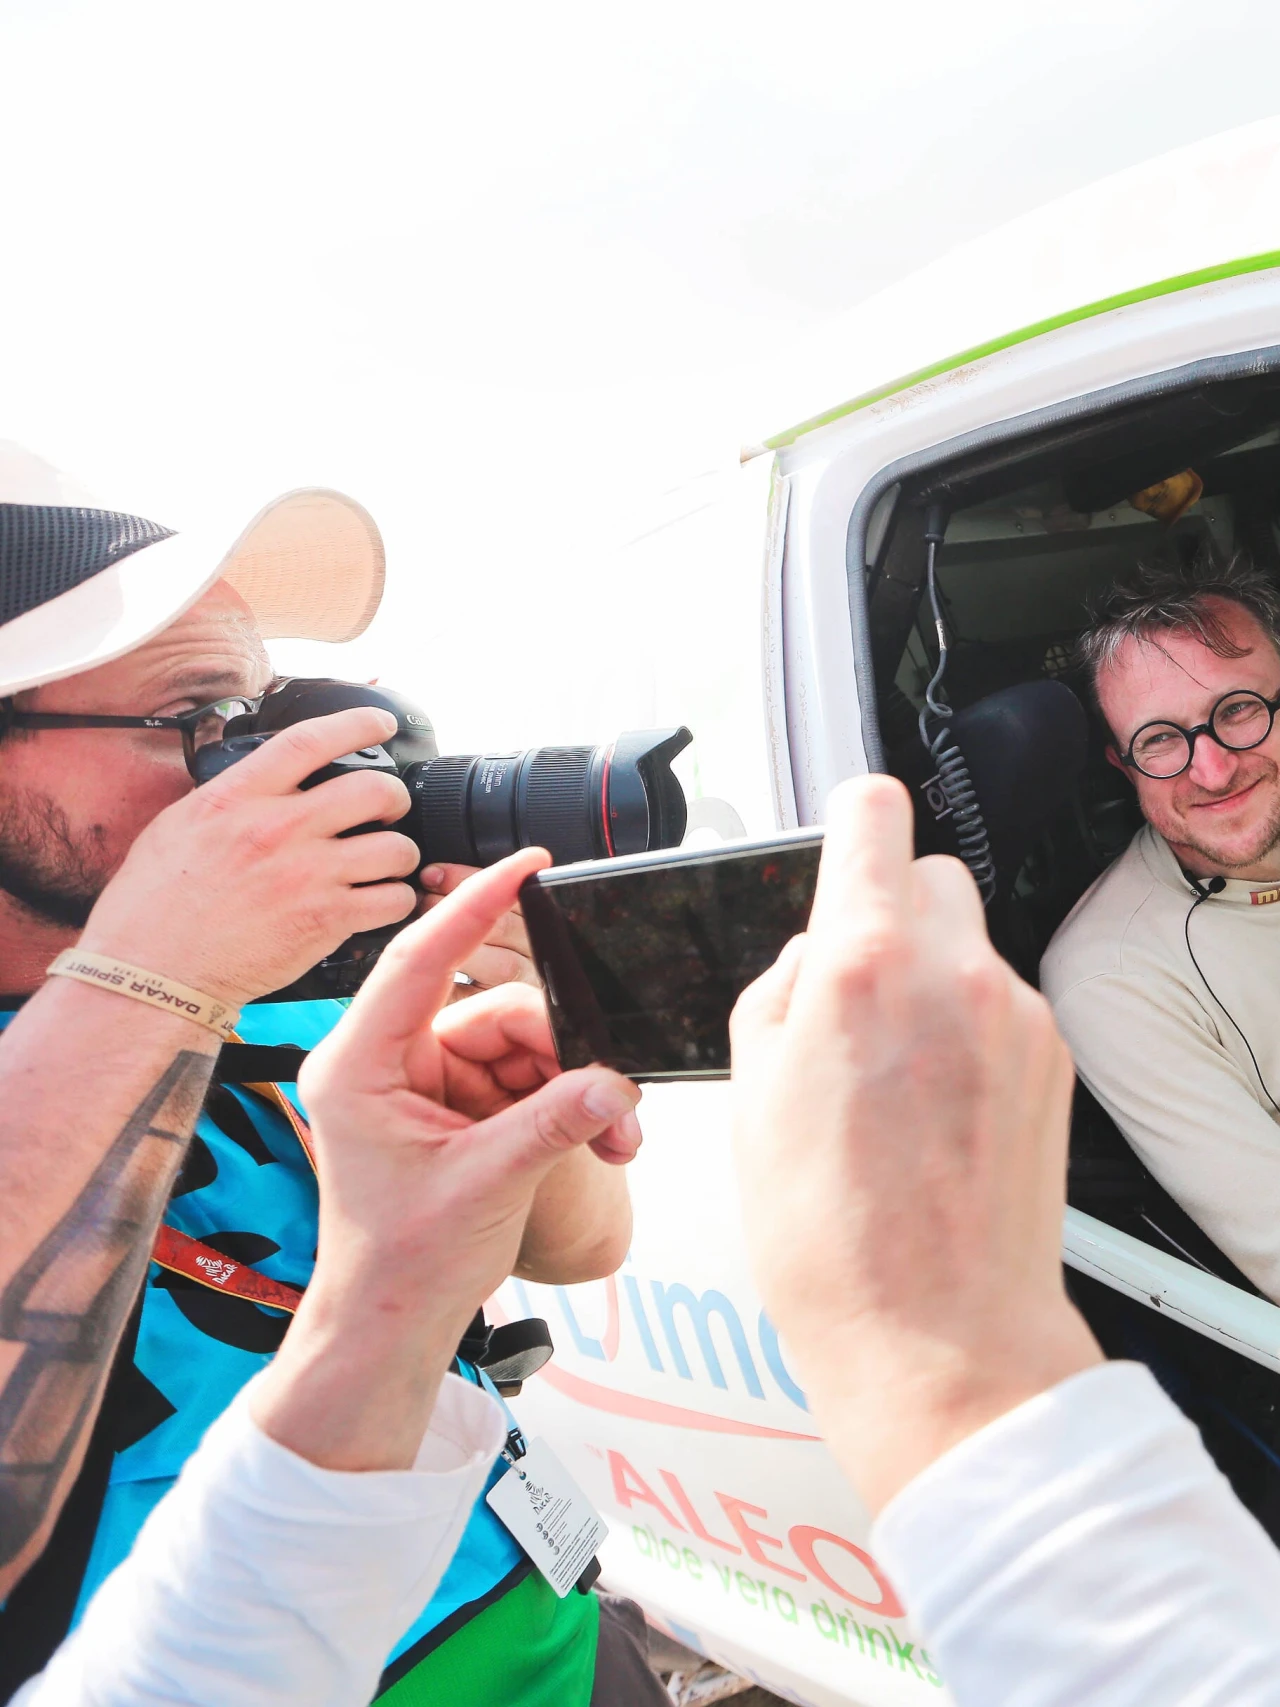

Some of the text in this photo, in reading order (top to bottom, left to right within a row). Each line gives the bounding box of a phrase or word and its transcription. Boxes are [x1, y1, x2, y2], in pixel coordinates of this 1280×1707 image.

[66, 961, 202, 1015] DAKAR SPIRIT
[607, 1449, 907, 1619] ALEO
[632, 1523, 703, 1580] aloe
[710, 1559, 799, 1625] vera
[811, 1598, 945, 1688] drinks
